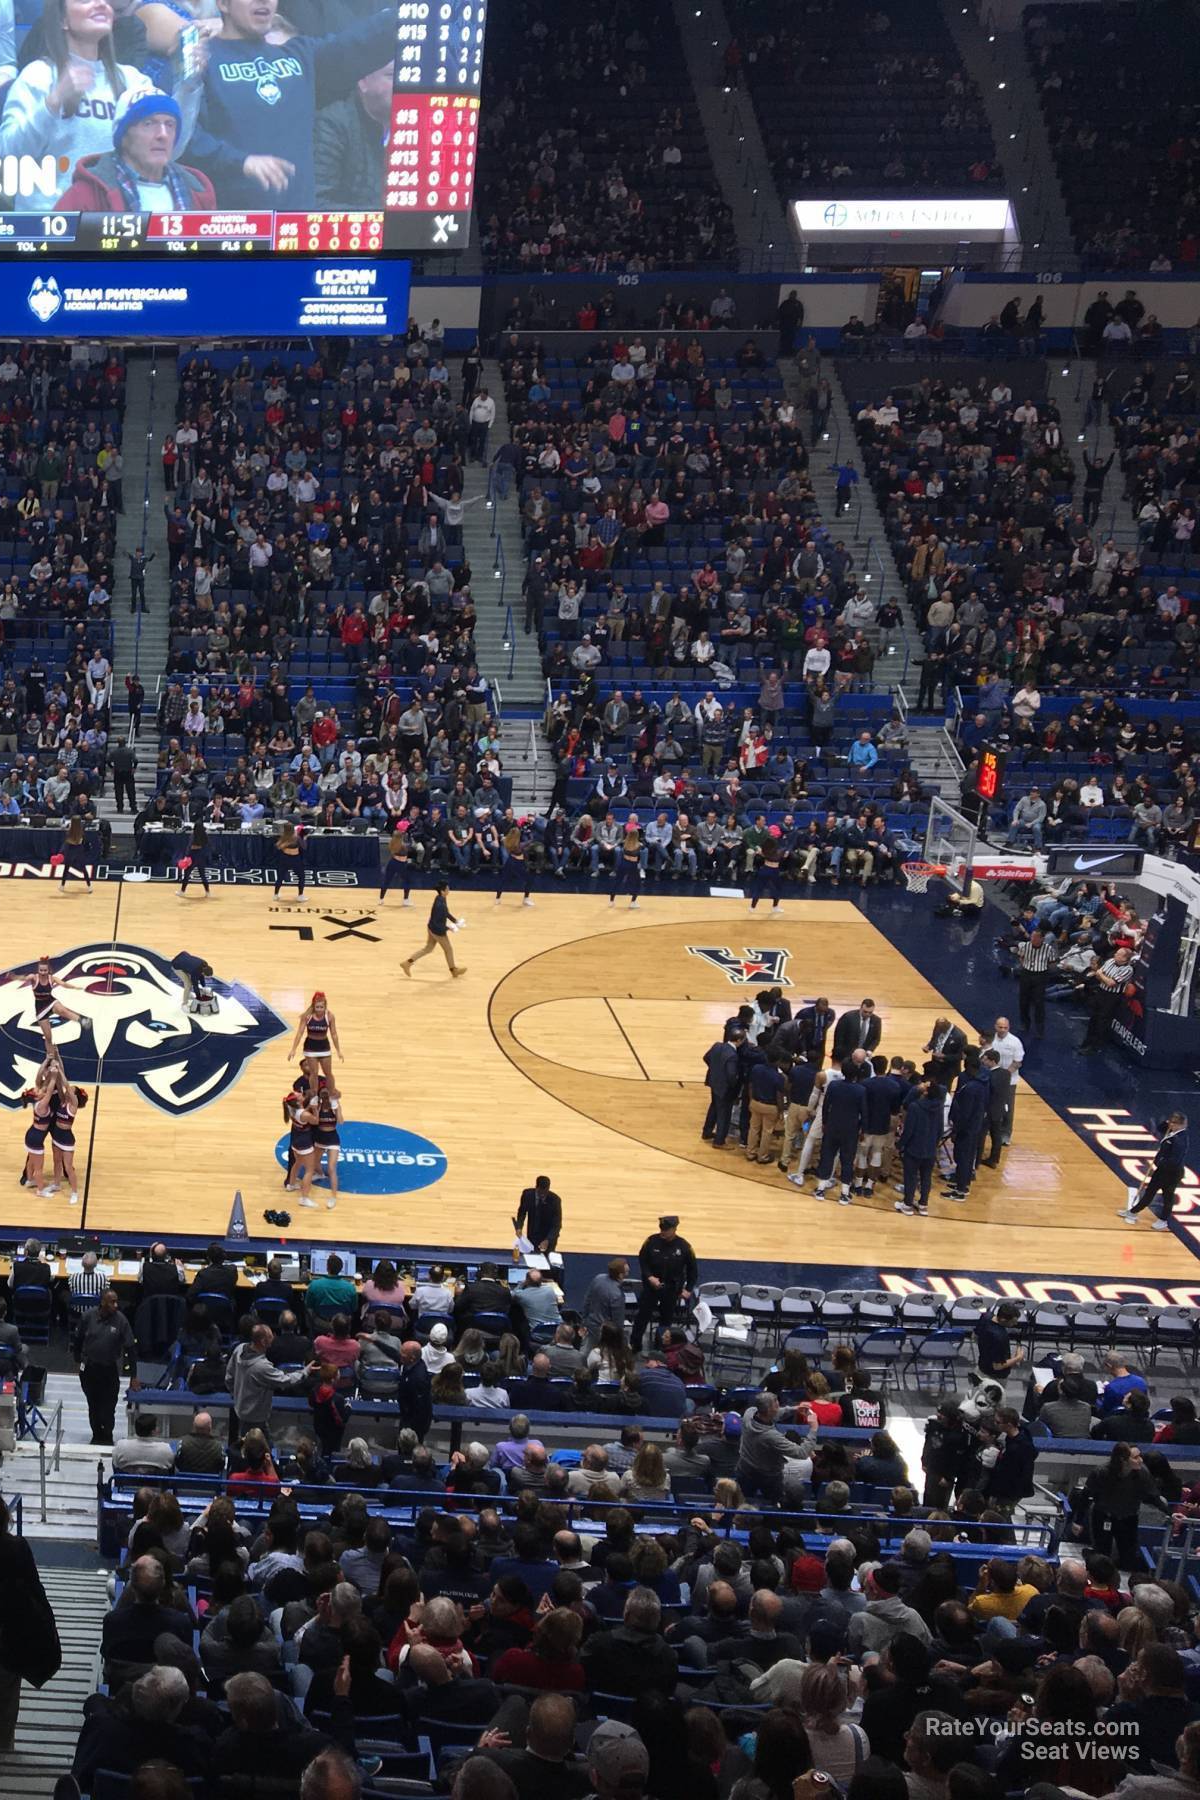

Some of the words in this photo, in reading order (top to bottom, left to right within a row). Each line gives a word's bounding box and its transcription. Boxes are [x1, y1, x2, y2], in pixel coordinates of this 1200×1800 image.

[399, 3, 429, 19] #10
[440, 4, 451, 19] 0
[398, 25, 427, 40] #15
[402, 45, 421, 61] #1
[440, 46, 446, 62] 1
[399, 66, 421, 82] #2
[436, 67, 446, 83] 2
[396, 109, 418, 125] #5
[432, 109, 444, 125] 0
[431, 130, 443, 146] 0
[387, 171, 419, 186] #24
[428, 171, 440, 186] 0
[427, 191, 438, 206] 0
[42, 216, 67, 236] 10
[102, 215, 142, 237] 11:51
[161, 216, 183, 236] 13
[200, 224, 257, 235] COUGARS
[432, 214, 458, 243] XL
[315, 269, 376, 285] UCONN
[616, 274, 639, 286] 105
[1035, 272, 1062, 283] 106
[64, 289, 101, 300] TEAM
[106, 289, 187, 301] PHYSICIANS
[321, 286, 369, 295] HEALTH
[64, 302, 96, 311] UCONN
[97, 302, 143, 311] ATHLETICS
[268, 907, 348, 915] CENTER
[269, 915, 383, 943] XL
[1111, 1018, 1148, 1056] TRAVELERS
